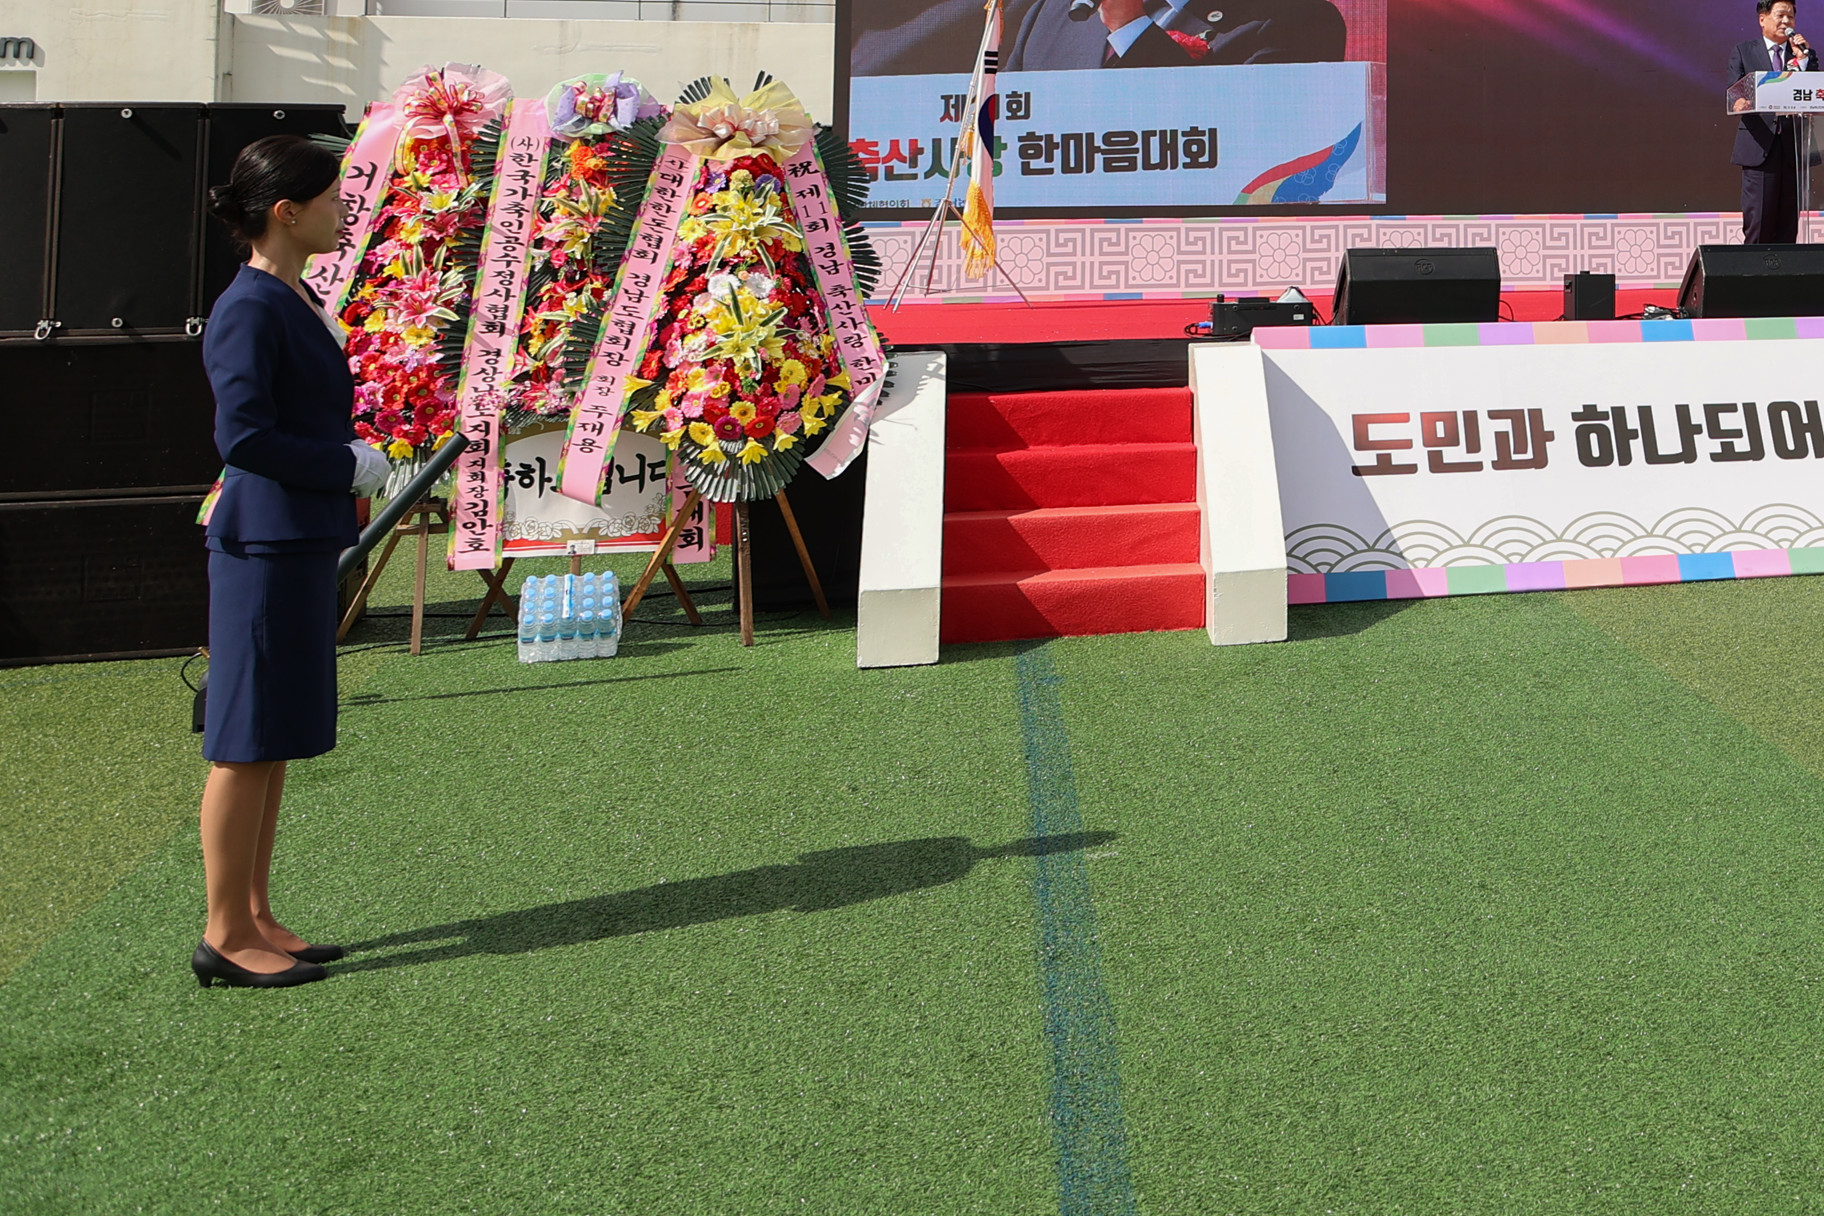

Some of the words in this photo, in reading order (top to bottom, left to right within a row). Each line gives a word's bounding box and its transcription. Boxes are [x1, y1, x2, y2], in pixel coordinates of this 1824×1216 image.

[1792, 88, 1813, 102] 경남
[787, 160, 821, 178] 祝
[1017, 125, 1218, 178] 한마음대회
[795, 184, 830, 233] 제11회
[814, 242, 844, 276] 경남
[826, 284, 869, 350] 축산사랑
[592, 375, 616, 397] 회장
[1350, 406, 1556, 477] 도민과
